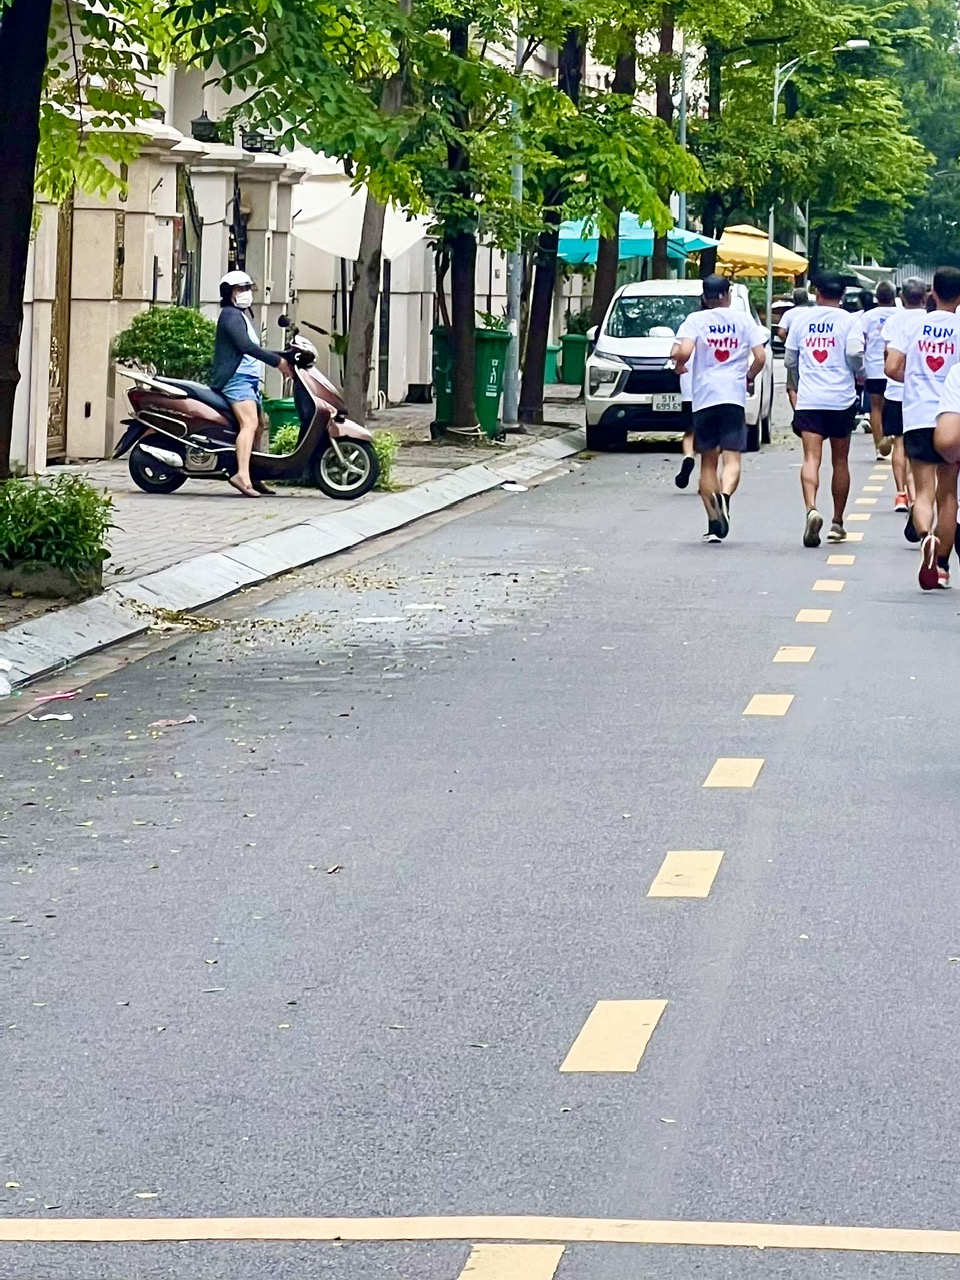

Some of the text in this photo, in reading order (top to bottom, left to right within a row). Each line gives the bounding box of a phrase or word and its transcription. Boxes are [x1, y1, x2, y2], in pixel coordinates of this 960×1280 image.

[709, 324, 736, 334] RUN
[808, 323, 834, 333] RUN
[923, 325, 954, 338] RUN
[707, 338, 738, 348] WITH
[806, 337, 836, 347] WITH
[918, 340, 954, 354] WITH
